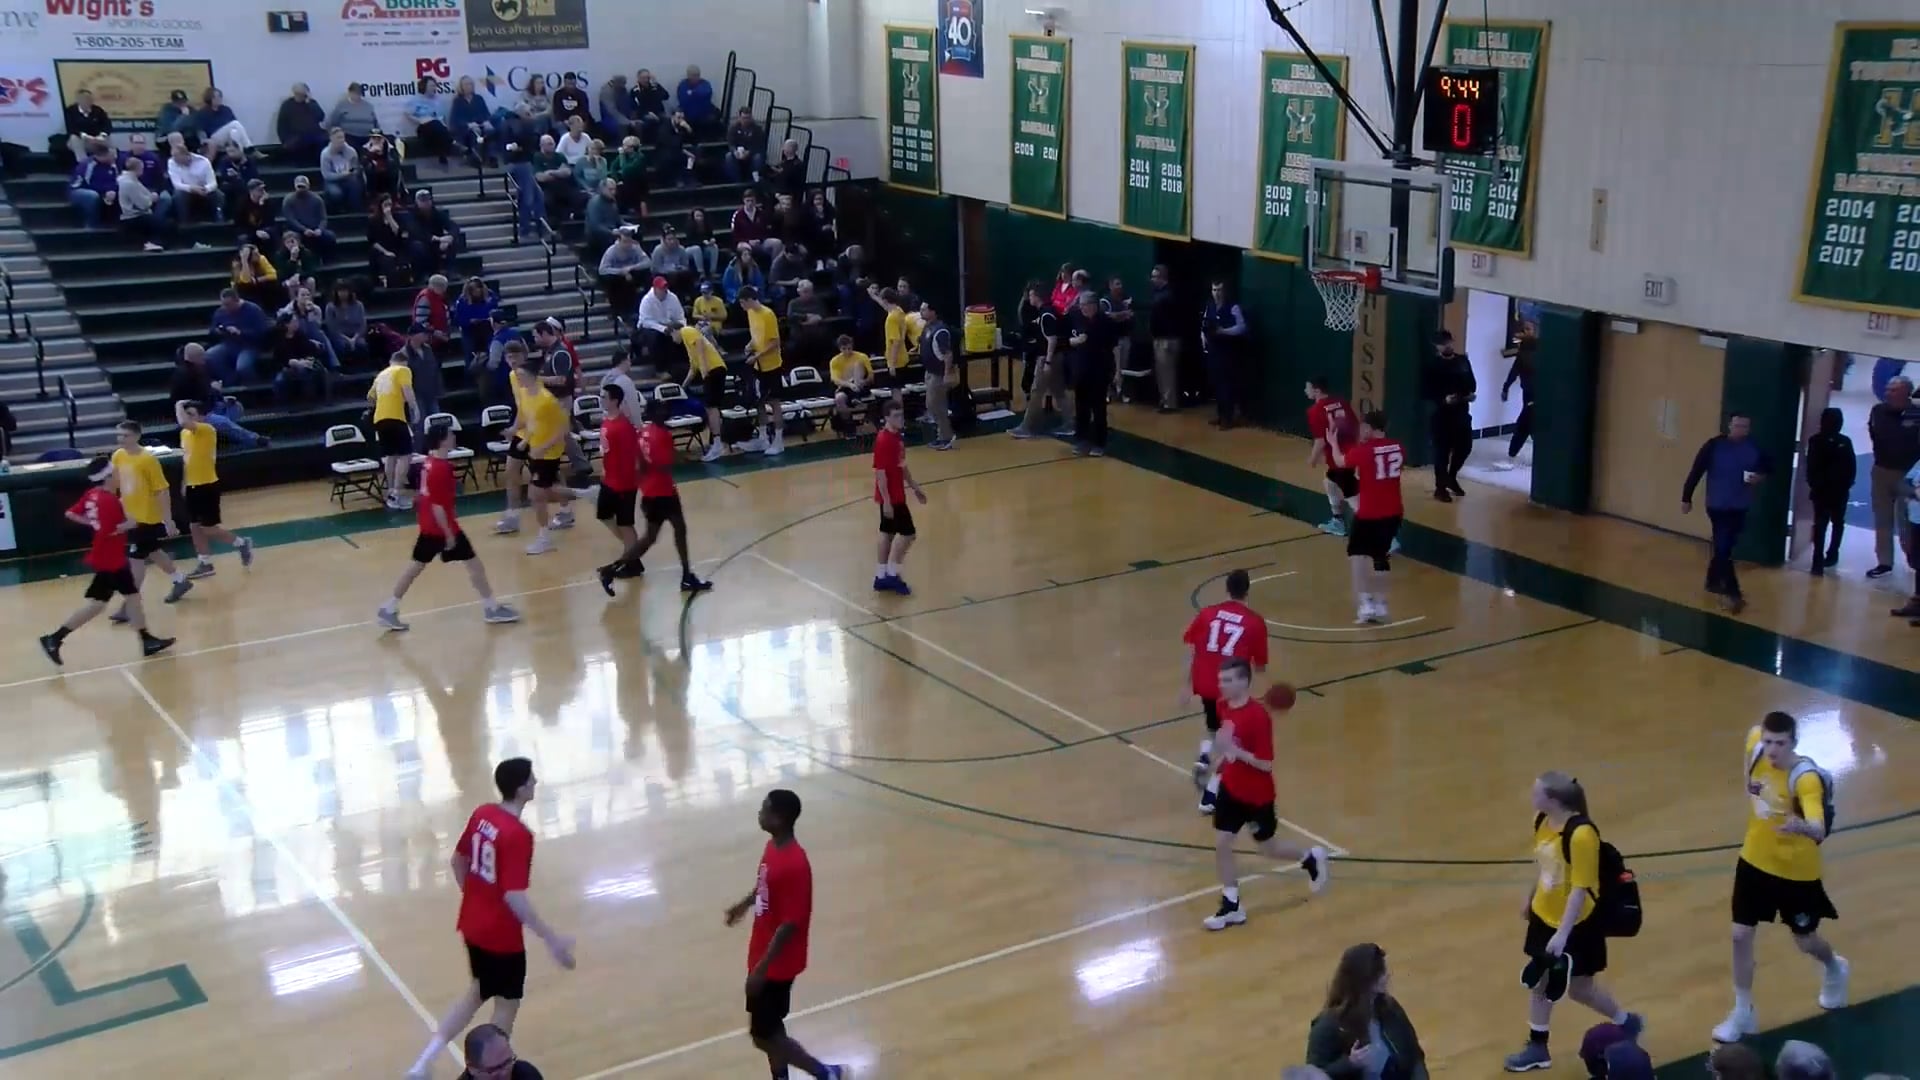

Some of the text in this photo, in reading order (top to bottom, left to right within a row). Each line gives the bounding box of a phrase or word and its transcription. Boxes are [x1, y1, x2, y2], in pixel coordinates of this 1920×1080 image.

[948, 16, 972, 46] 40
[75, 36, 185, 48] 1-800-205-TEAM
[416, 58, 450, 79] PG
[361, 82, 415, 98] Portland
[1440, 76, 1480, 99] 9:44
[1453, 104, 1471, 147] 0
[1130, 158, 1182, 178] 2014 2016
[1129, 173, 1182, 193] 2017 2018
[1265, 185, 1292, 201] 2009
[1489, 183, 1518, 202] 2014
[1265, 200, 1290, 217] 2014
[1488, 201, 1517, 220] 2017
[1826, 198, 1876, 219] 2004
[1825, 223, 1867, 245] 2011
[1472, 253, 1487, 269] EXIT
[1819, 244, 1864, 267] 2017
[1645, 280, 1663, 298] EXIT
[1867, 312, 1890, 331] EXIT
[1375, 452, 1404, 480] 12
[1206, 619, 1245, 657] 17
